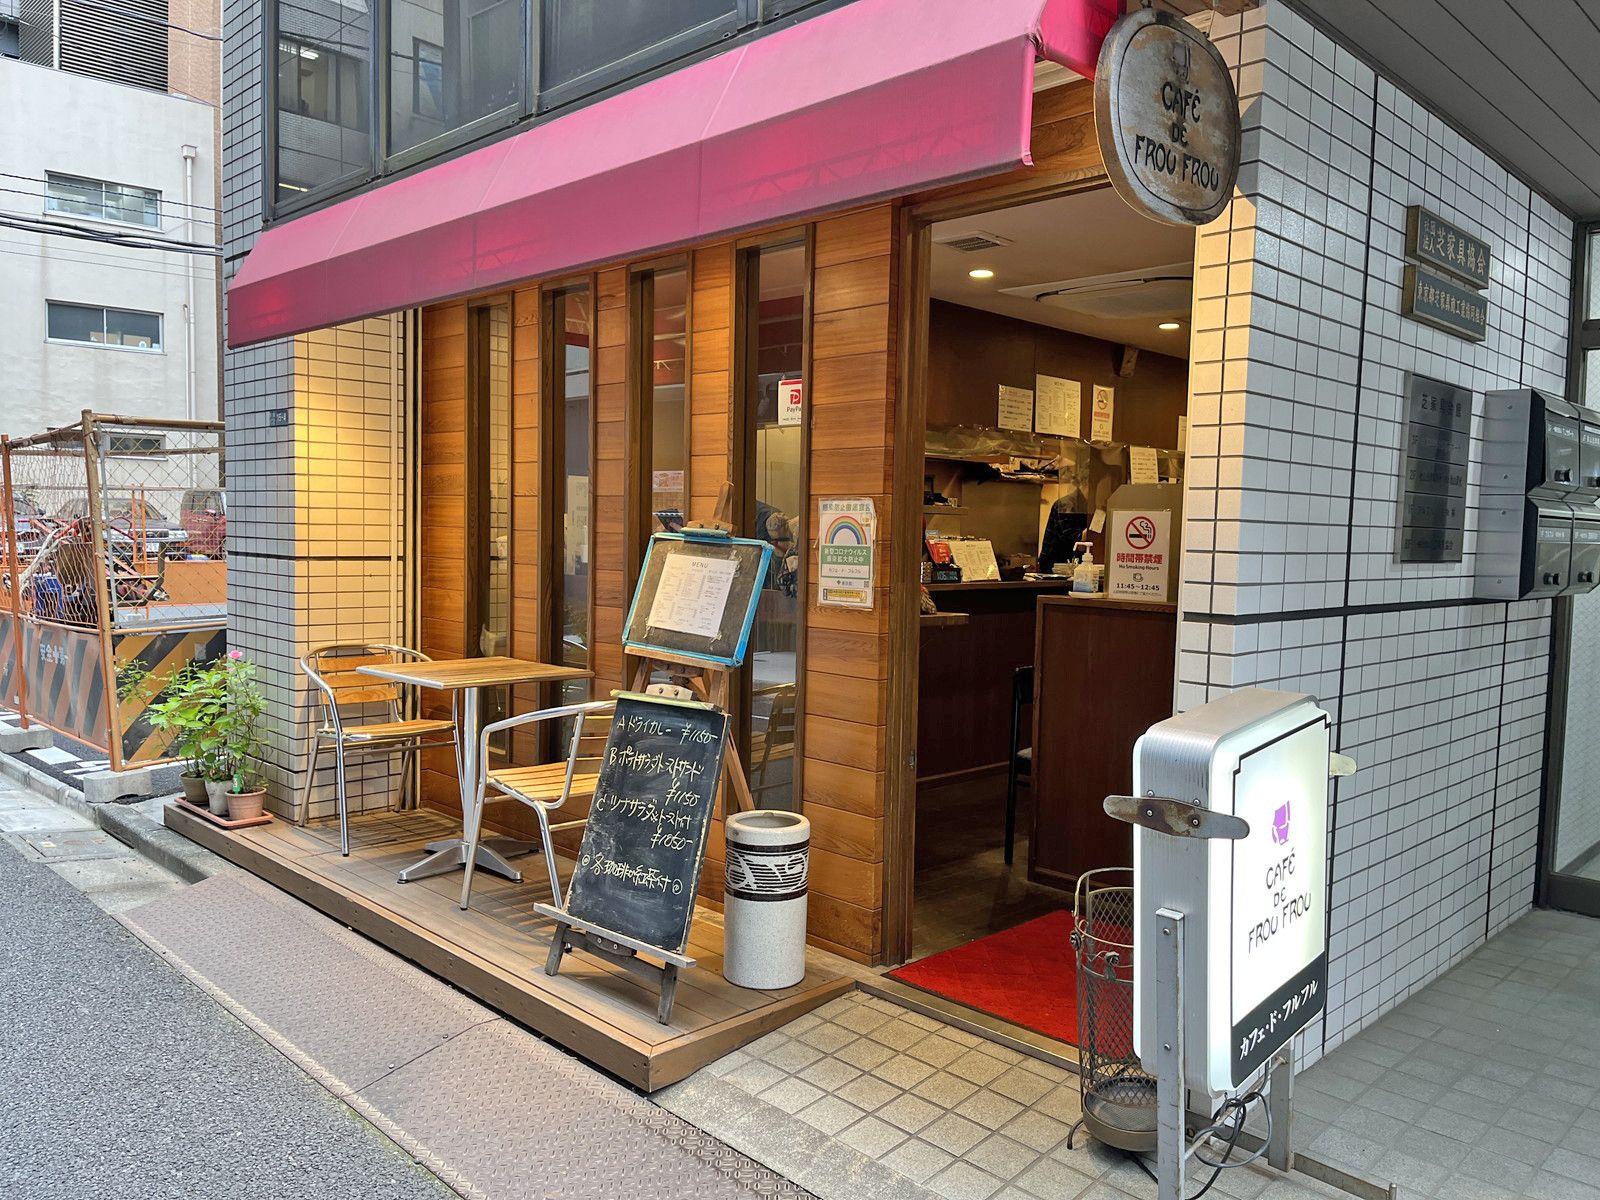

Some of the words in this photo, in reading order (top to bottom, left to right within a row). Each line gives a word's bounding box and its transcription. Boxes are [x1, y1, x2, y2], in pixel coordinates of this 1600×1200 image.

[1161, 81, 1201, 123] CAFÉ
[1170, 122, 1189, 147] DE
[1134, 133, 1177, 176] FROU
[1182, 153, 1219, 192] FROU
[691, 561, 709, 569] MENU
[1117, 553, 1162, 564] 時間帯禁煙
[616, 717, 626, 729] A
[628, 714, 672, 737] ドライカレー
[609, 746, 618, 766] B
[596, 793, 607, 812] C
[1265, 847, 1296, 890] CAFÉ
[1273, 886, 1287, 909] DE
[1248, 915, 1279, 954] FROU
[1282, 892, 1312, 929] FROU
[1239, 979, 1319, 1061] カフェ・ド・フルフル
